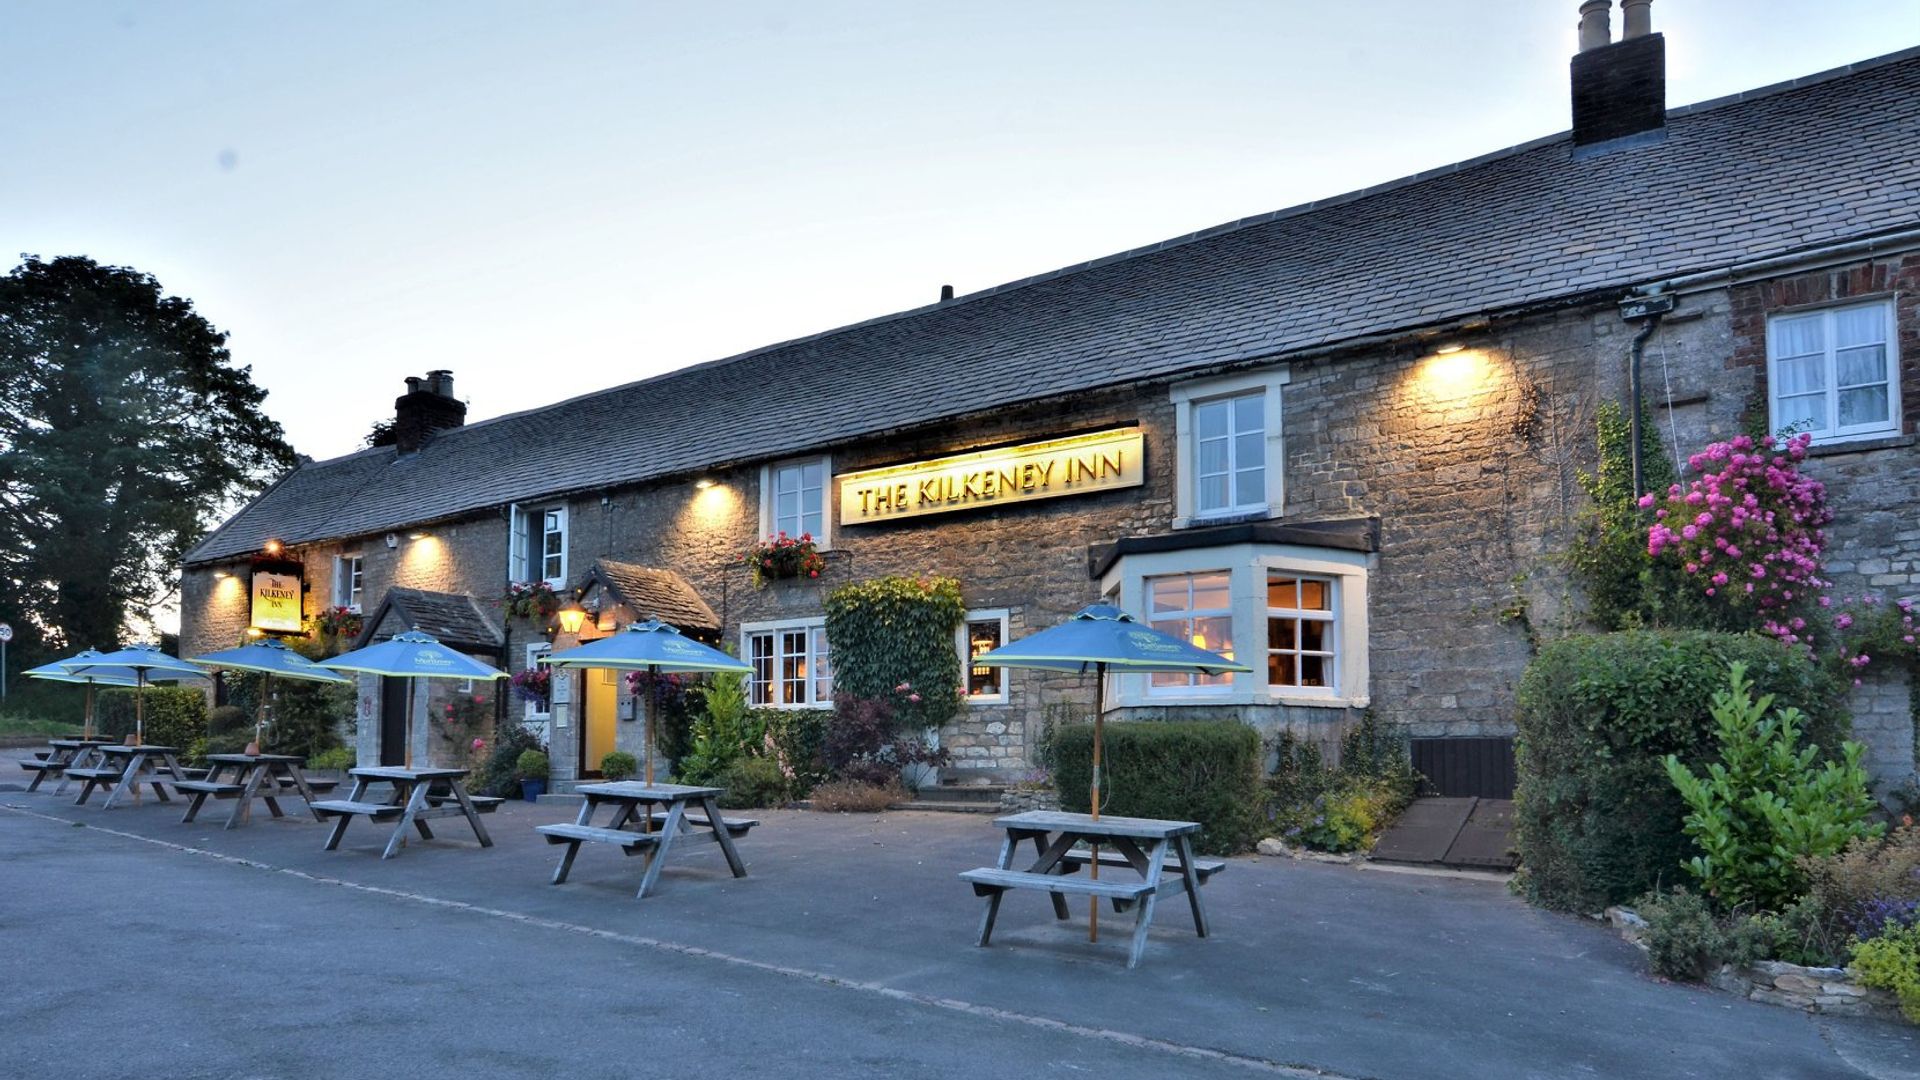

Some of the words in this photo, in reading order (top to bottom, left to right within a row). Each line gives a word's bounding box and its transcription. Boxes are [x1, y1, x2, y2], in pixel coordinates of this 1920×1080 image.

[858, 483, 908, 513] THE
[917, 460, 1056, 504] KILKENEY
[1064, 450, 1123, 483] INN
[269, 578, 283, 588] THE
[260, 588, 294, 601] KILKENEY
